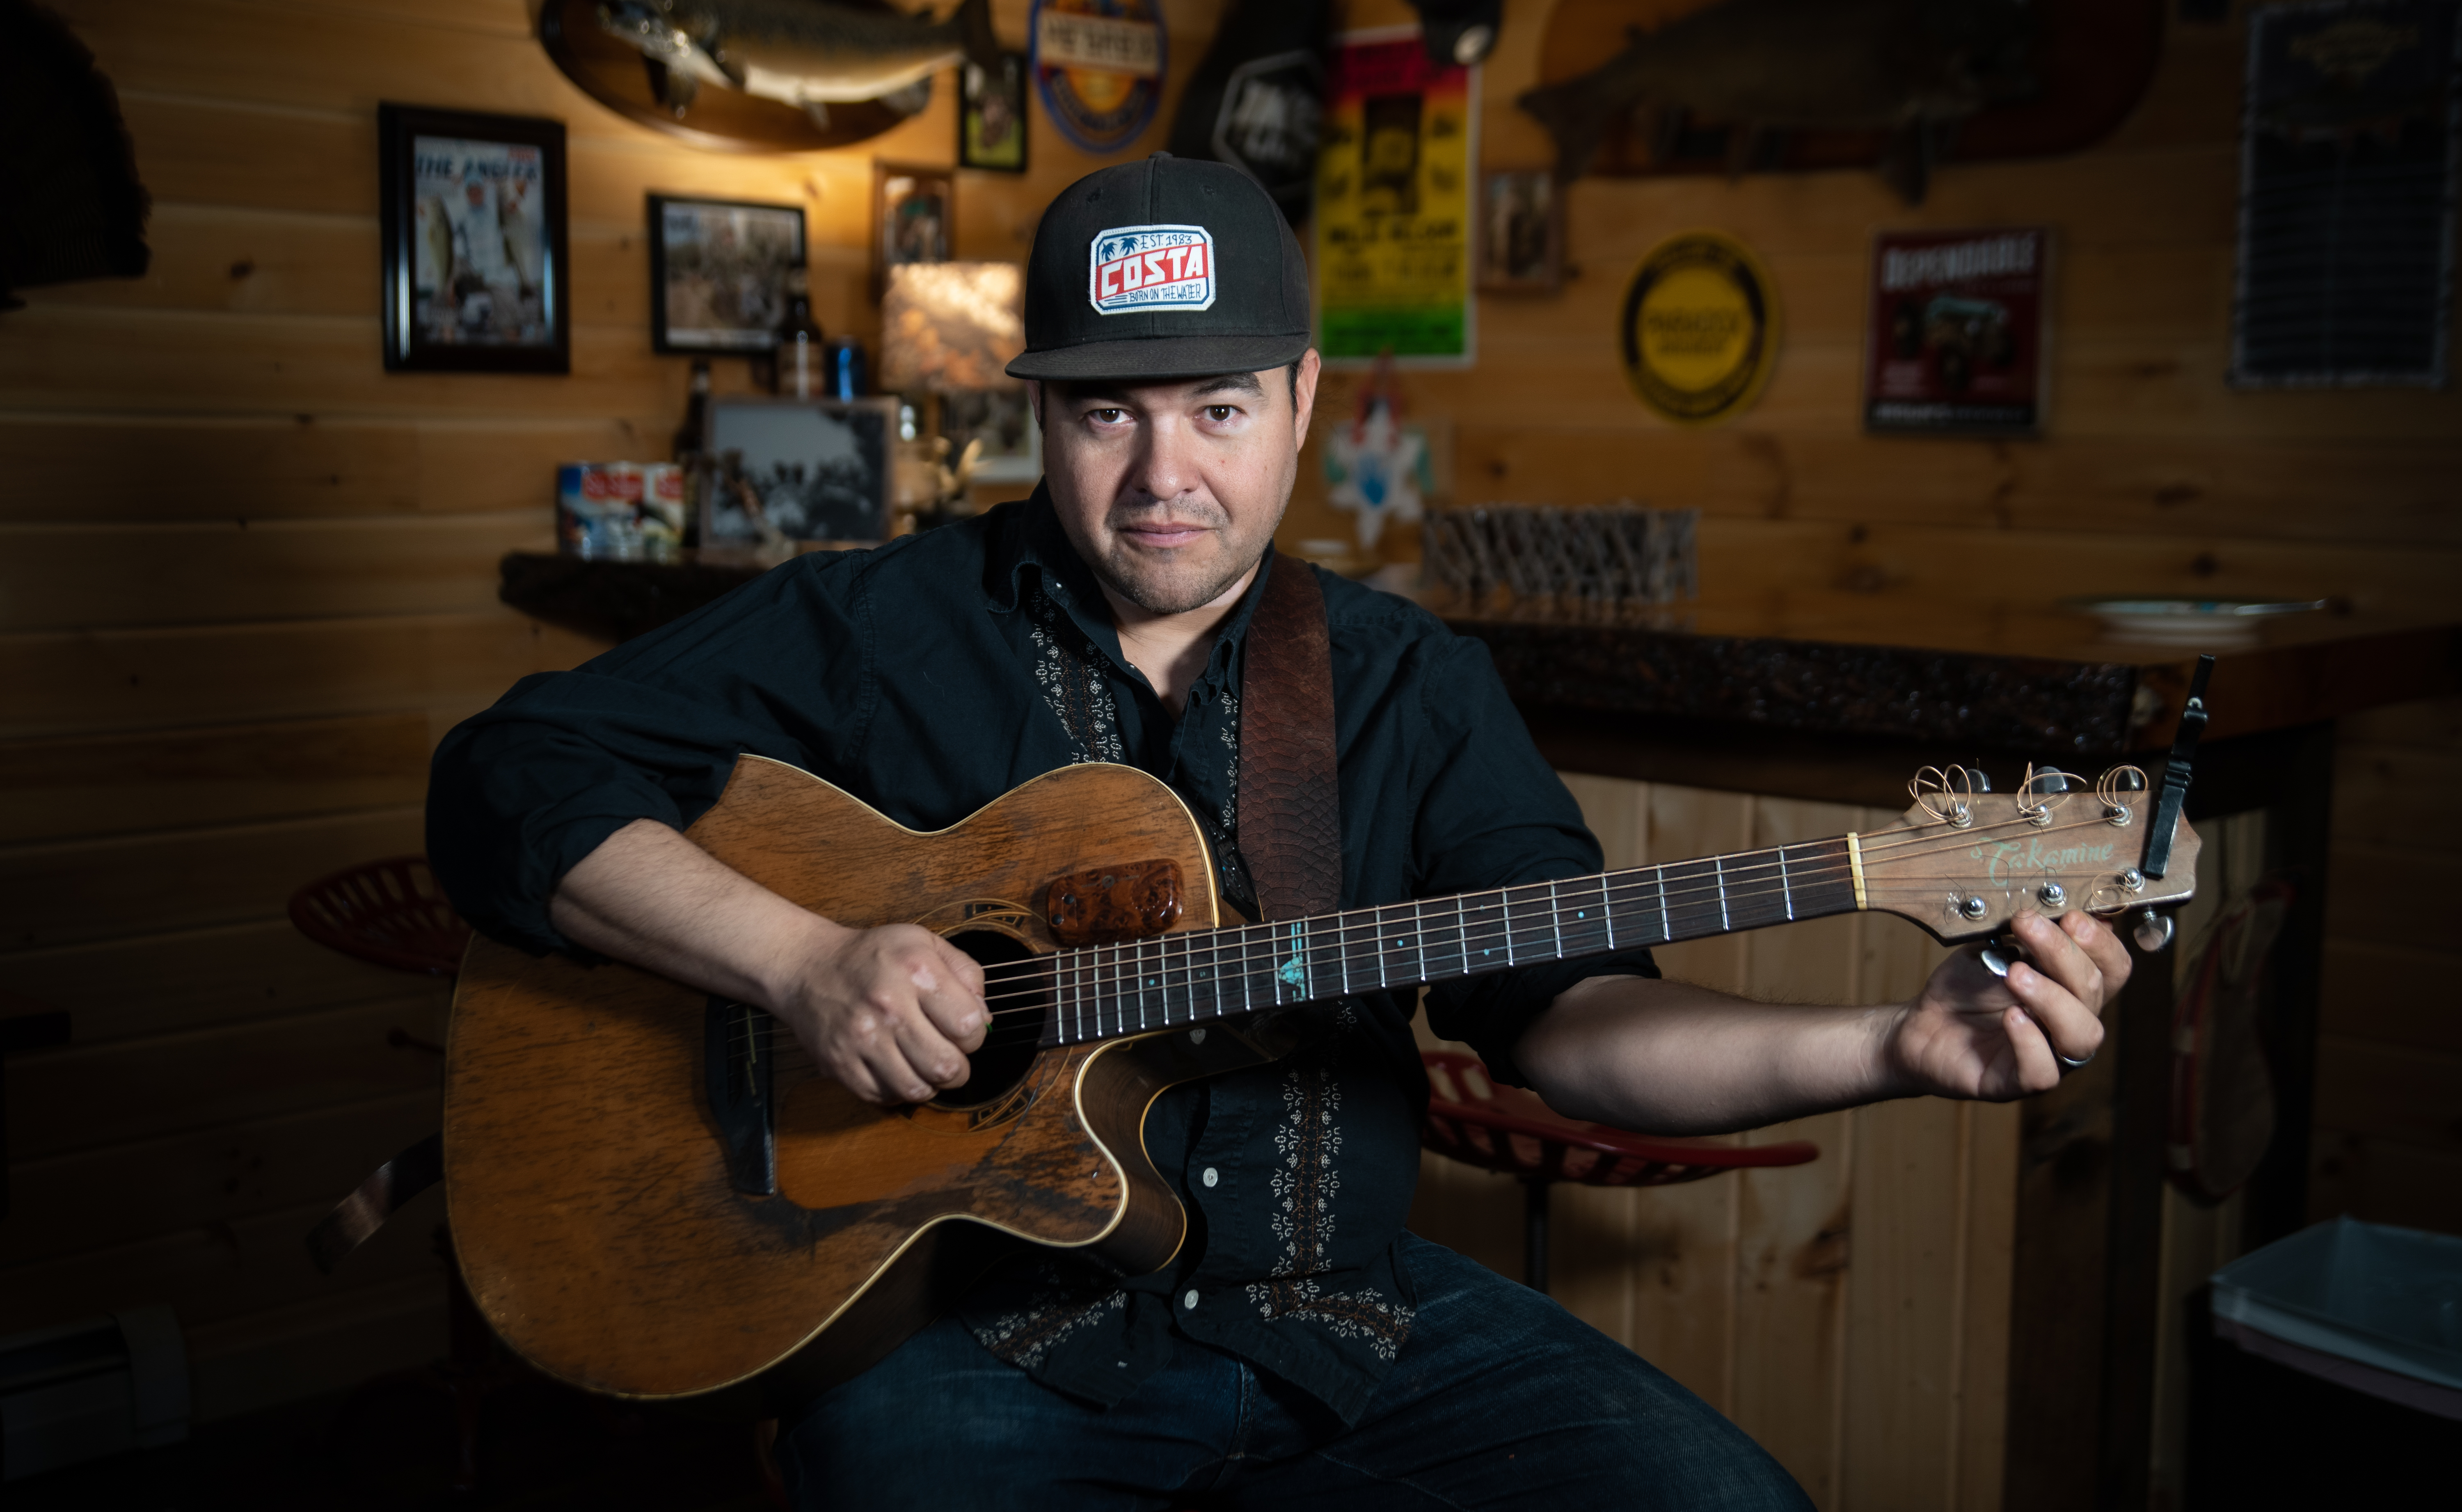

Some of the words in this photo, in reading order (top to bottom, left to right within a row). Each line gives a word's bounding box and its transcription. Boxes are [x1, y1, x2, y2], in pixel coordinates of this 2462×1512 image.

[1140, 234, 1163, 249] EST.
[1166, 234, 1192, 245] 1983
[1101, 245, 1204, 298] COSTA
[1128, 290, 1148, 302] BORN
[1149, 288, 1159, 300] ON
[1970, 837, 2114, 886] Takamine
